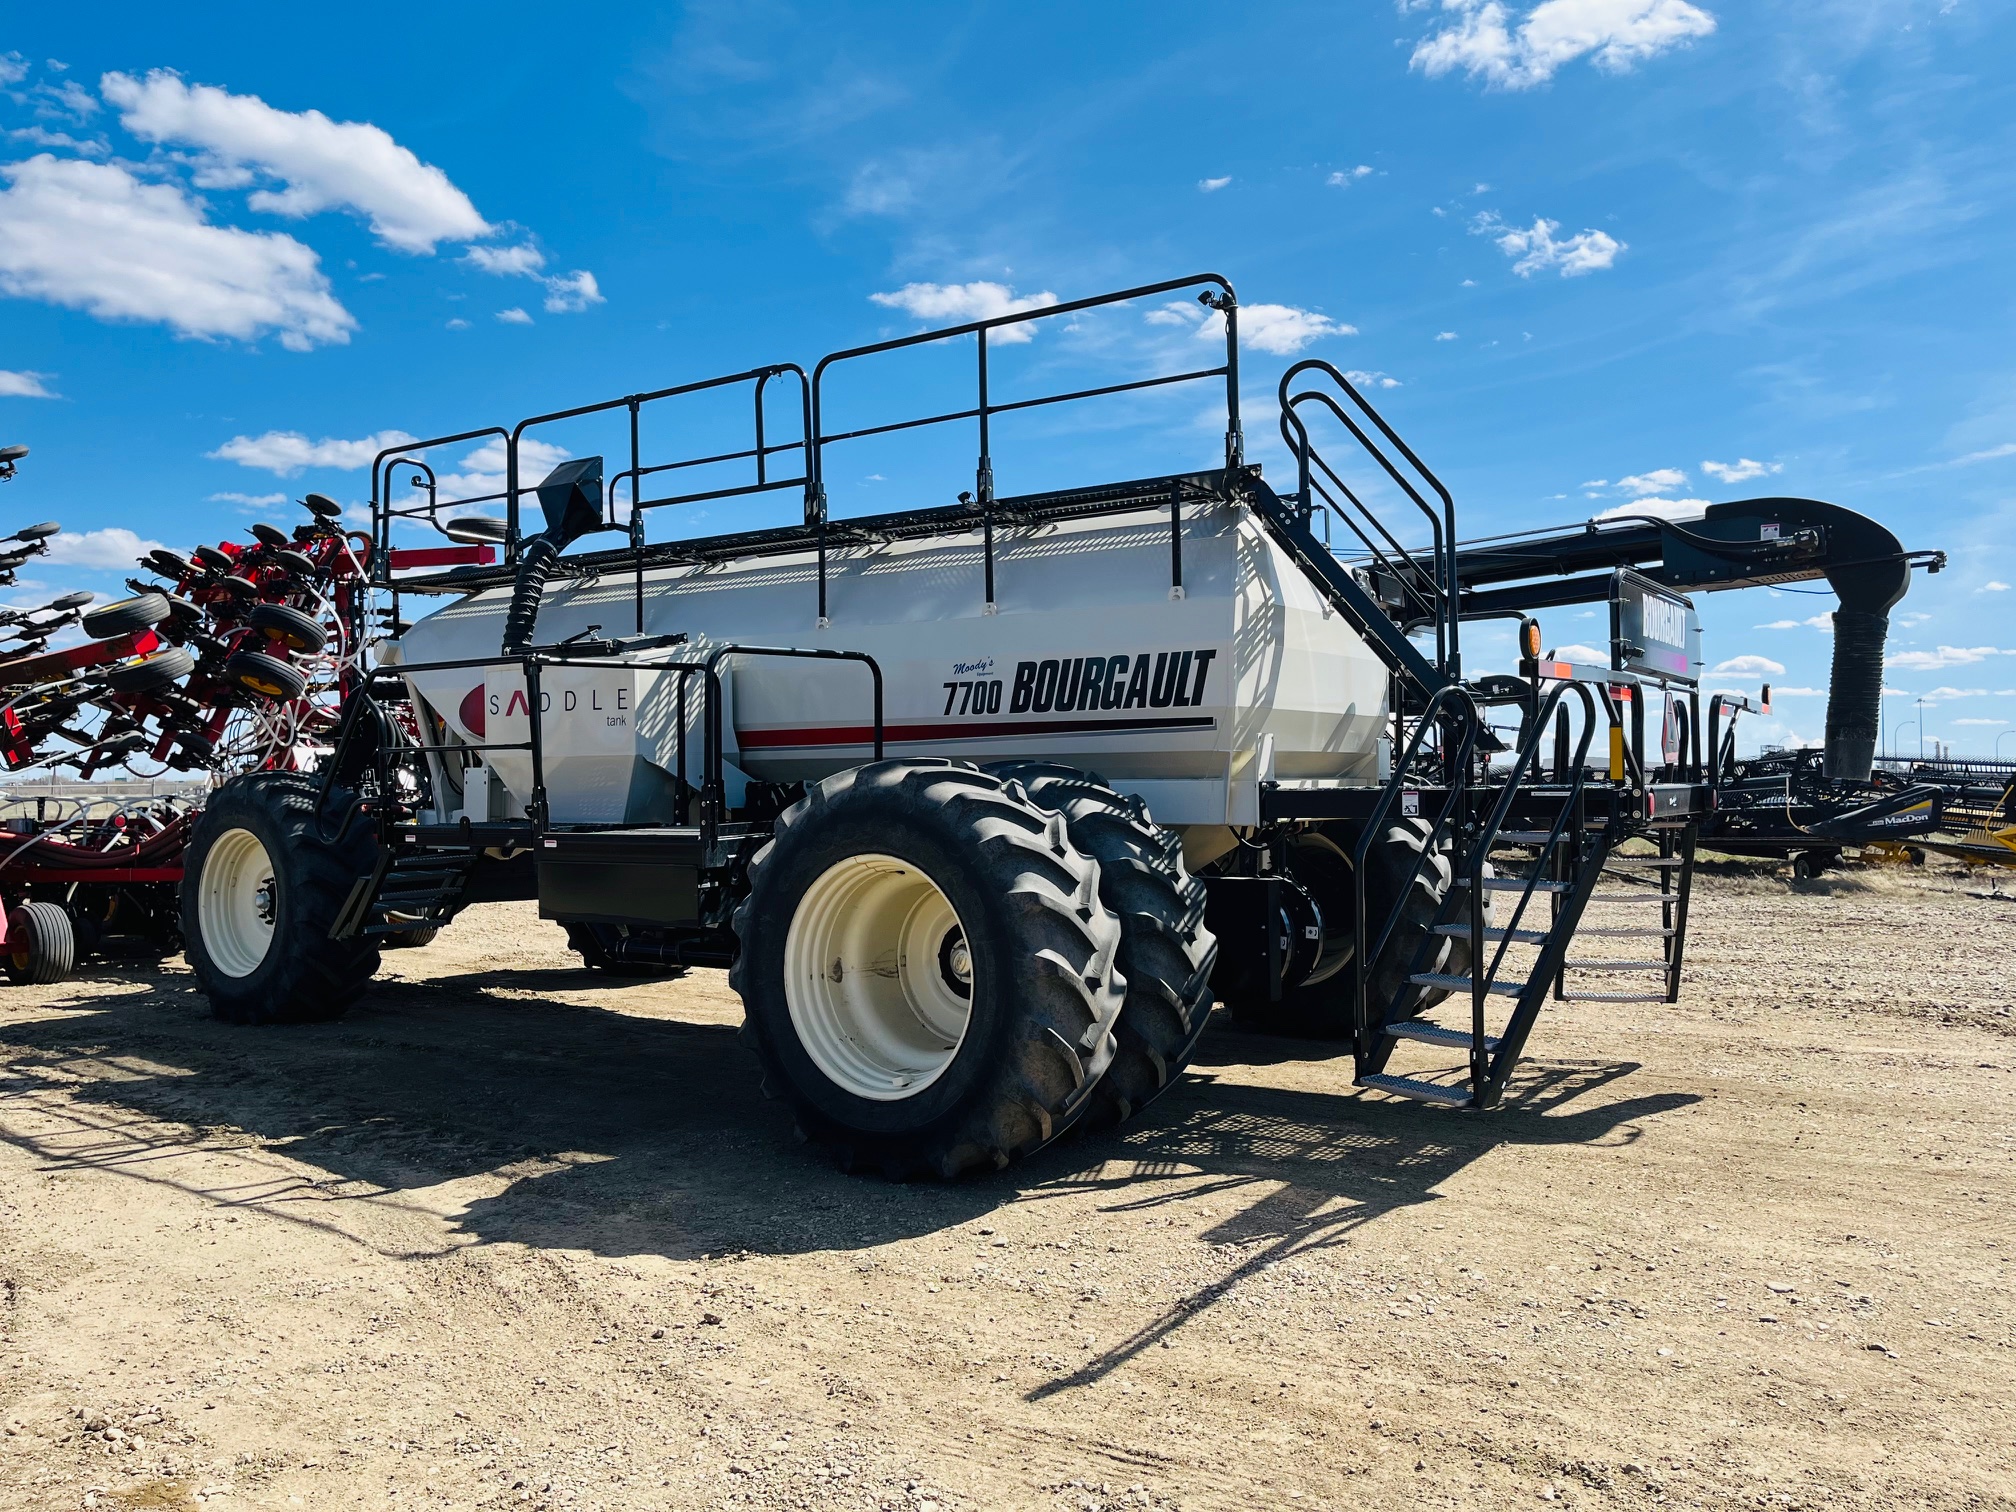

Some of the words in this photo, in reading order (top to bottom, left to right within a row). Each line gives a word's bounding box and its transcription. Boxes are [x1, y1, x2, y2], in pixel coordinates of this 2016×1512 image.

[1642, 593, 1686, 649] BOURGAULT
[953, 656, 995, 675] Moody's
[943, 680, 1002, 715] 7700
[1009, 649, 1217, 713] BOURGAULT
[489, 688, 628, 717] SADDLE
[606, 714, 627, 727] tank
[1885, 814, 1929, 825] MacDon
